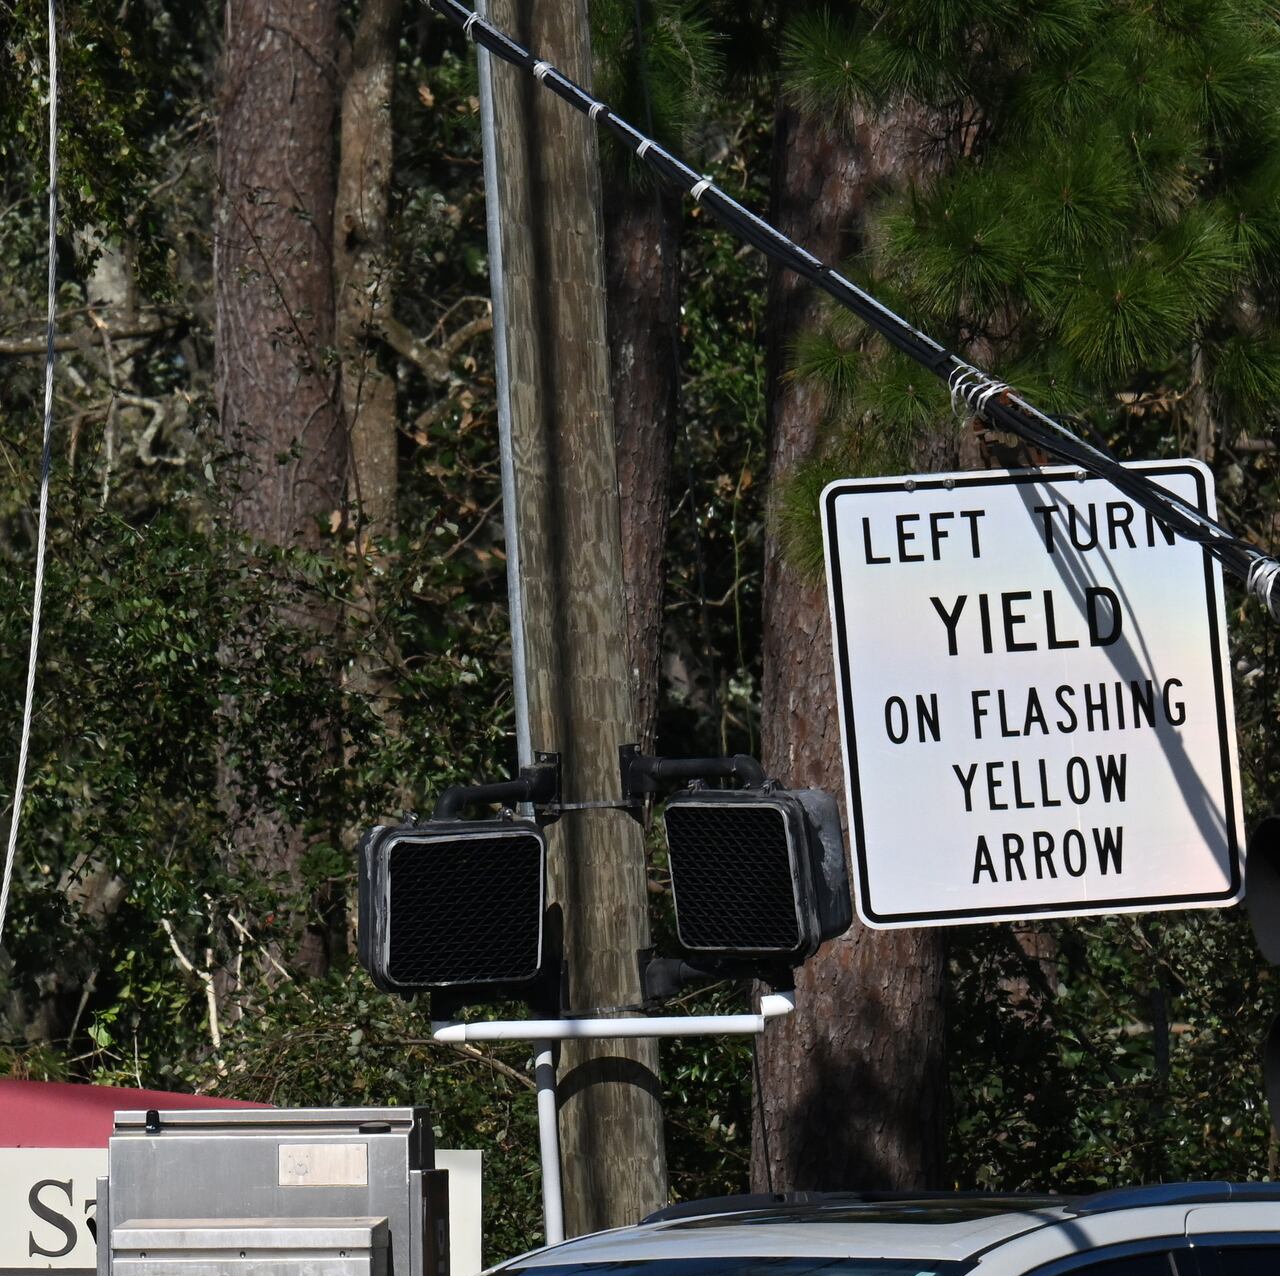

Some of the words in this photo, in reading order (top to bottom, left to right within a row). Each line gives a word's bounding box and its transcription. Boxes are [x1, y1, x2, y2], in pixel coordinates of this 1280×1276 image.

[862, 509, 986, 566] LEFT
[1033, 500, 1178, 555] TURN
[929, 586, 1123, 656] YIELD
[884, 693, 941, 745] ON
[971, 677, 1188, 740] FLASHING
[951, 753, 1128, 812] YELLOW
[972, 826, 1124, 884] ARROW
